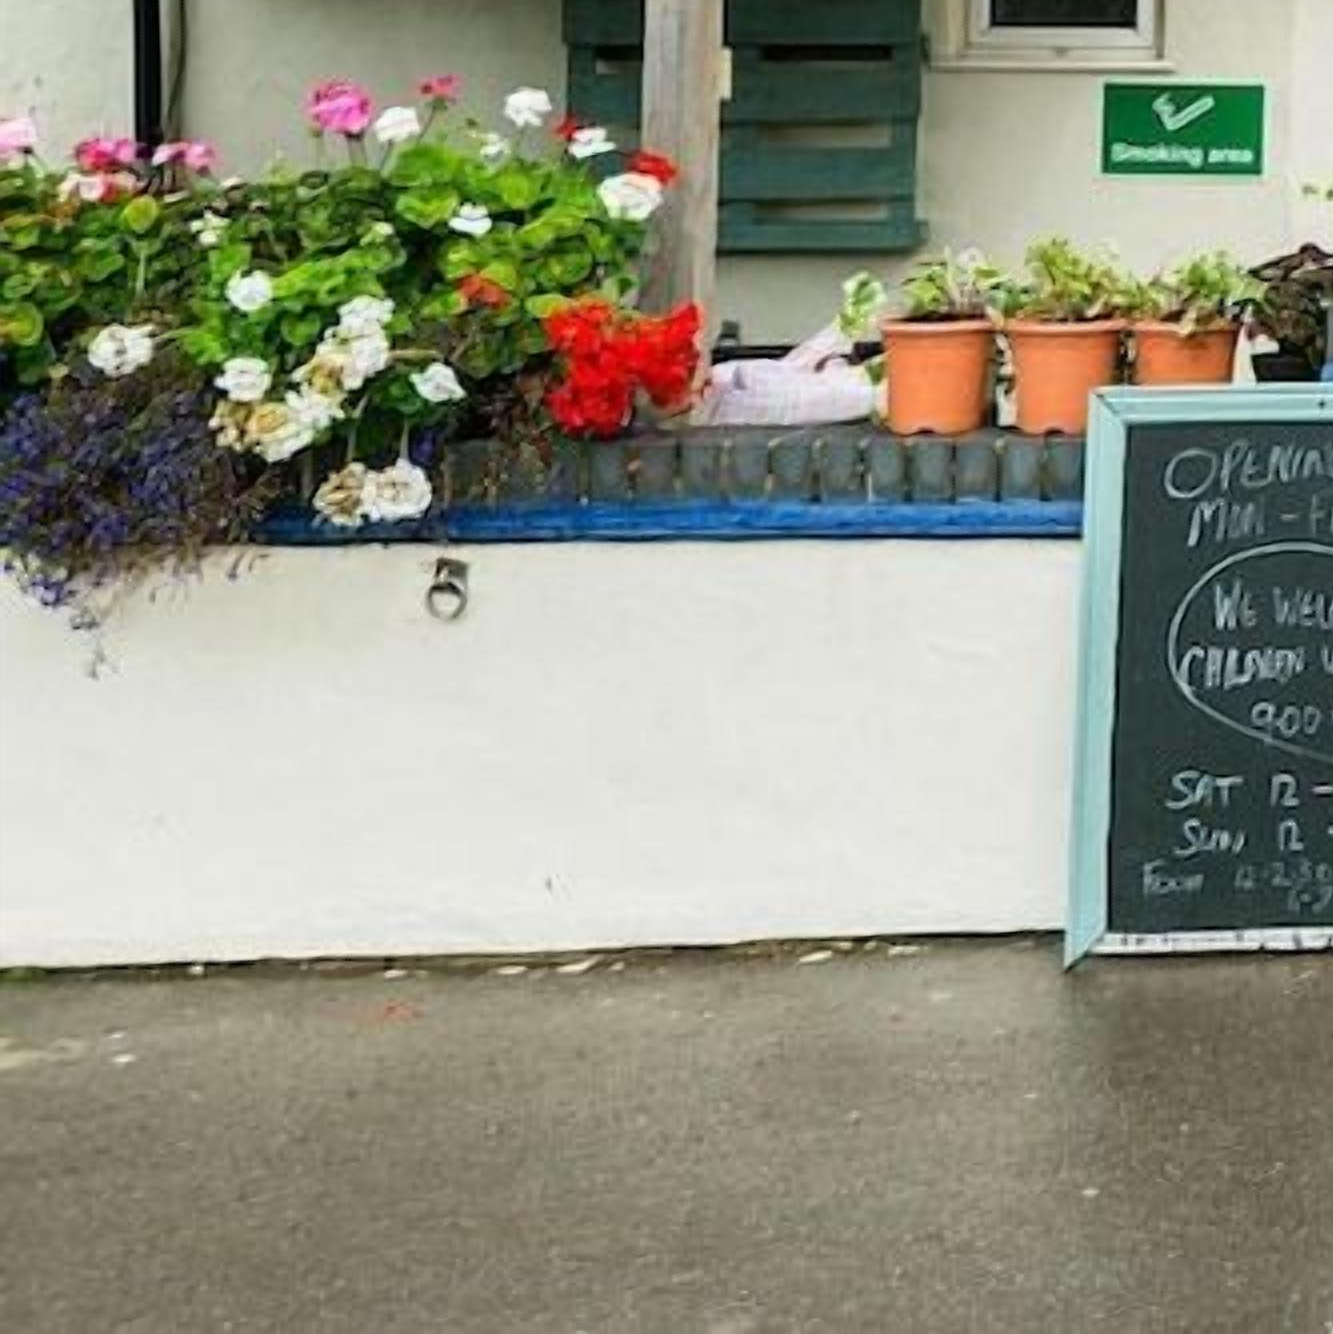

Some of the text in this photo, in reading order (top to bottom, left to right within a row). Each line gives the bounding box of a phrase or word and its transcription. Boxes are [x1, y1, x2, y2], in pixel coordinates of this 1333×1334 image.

[1111, 143, 1253, 168] Smoking area
[1165, 770, 1243, 809] SAT
